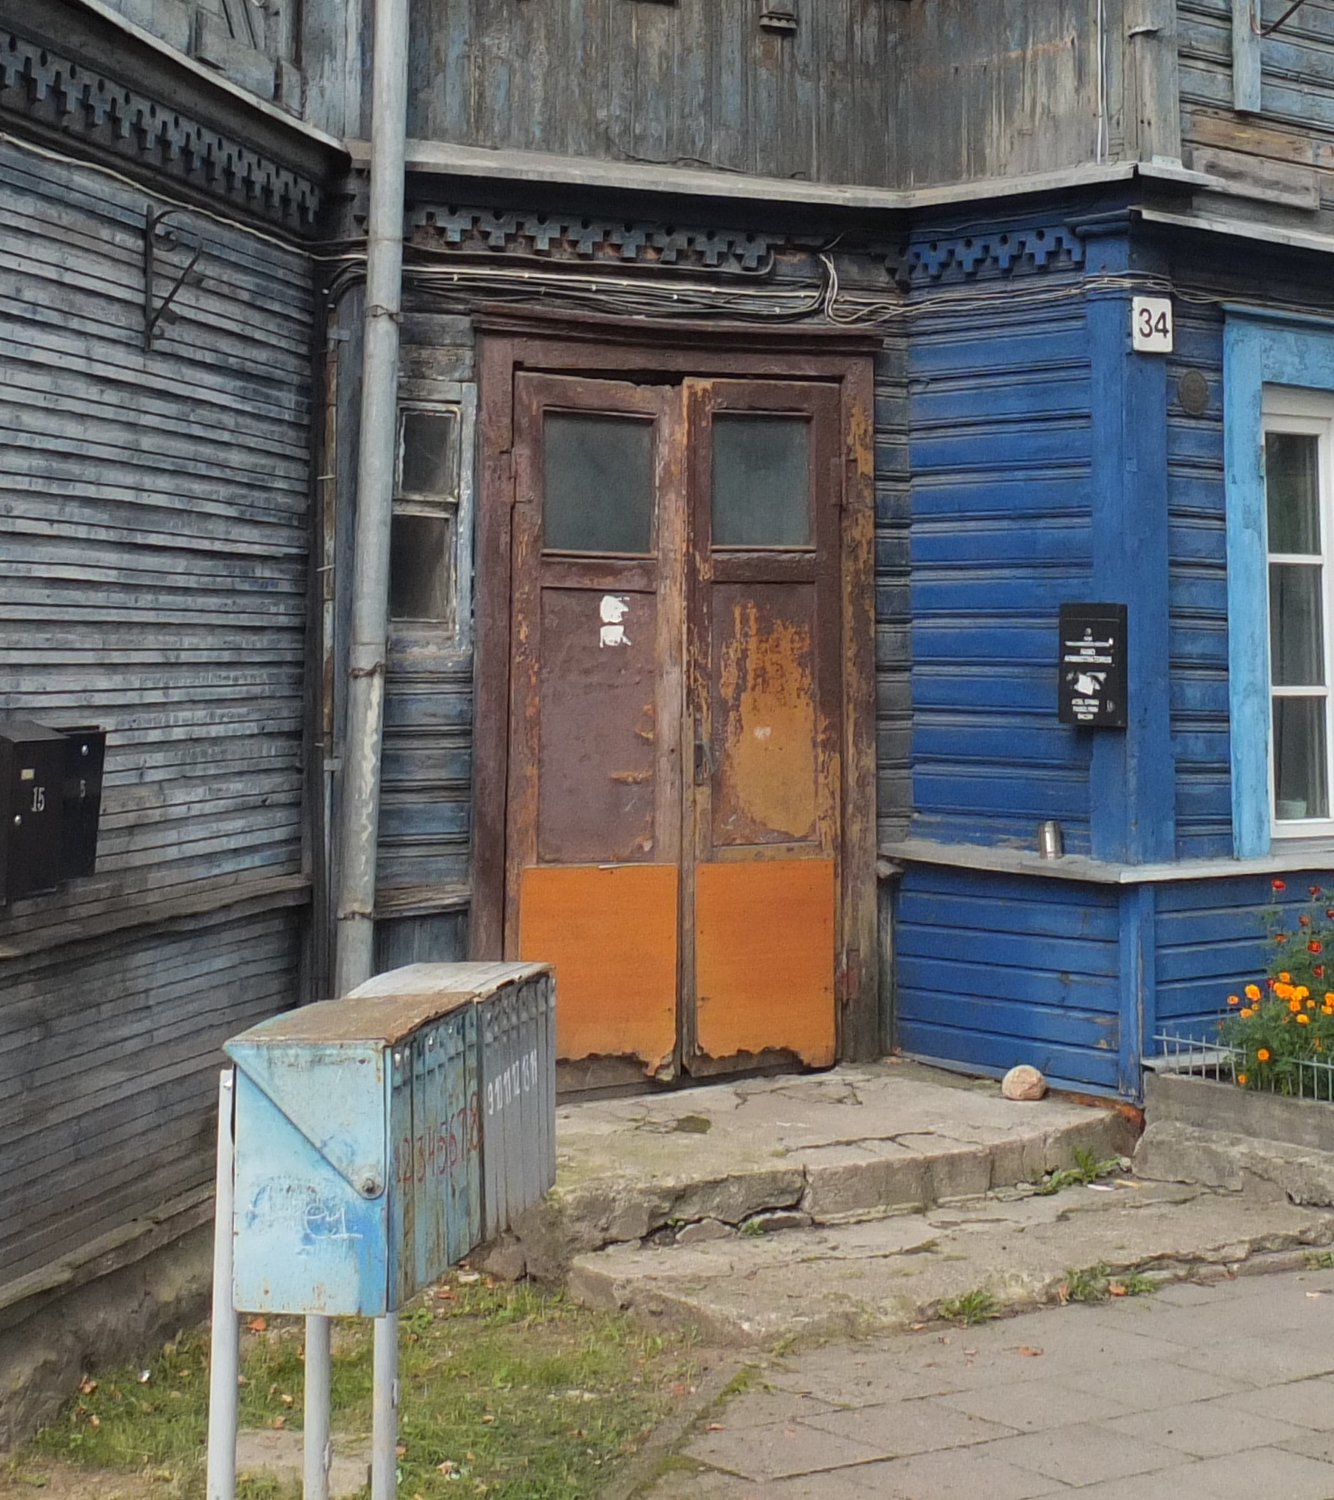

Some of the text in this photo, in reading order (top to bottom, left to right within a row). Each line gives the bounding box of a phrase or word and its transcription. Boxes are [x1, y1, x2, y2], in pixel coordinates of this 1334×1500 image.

[1139, 308, 1170, 339] 34
[30, 786, 46, 812] 15
[79, 779, 86, 798] 5
[488, 1082, 494, 1115] 9
[495, 1075, 503, 1111] 10
[403, 1136, 413, 1184] 2
[417, 1135, 426, 1184] 3
[428, 1125, 436, 1178] 4
[449, 1112, 458, 1168] 6
[456, 1107, 466, 1162] 7
[470, 1091, 480, 1151] 8
